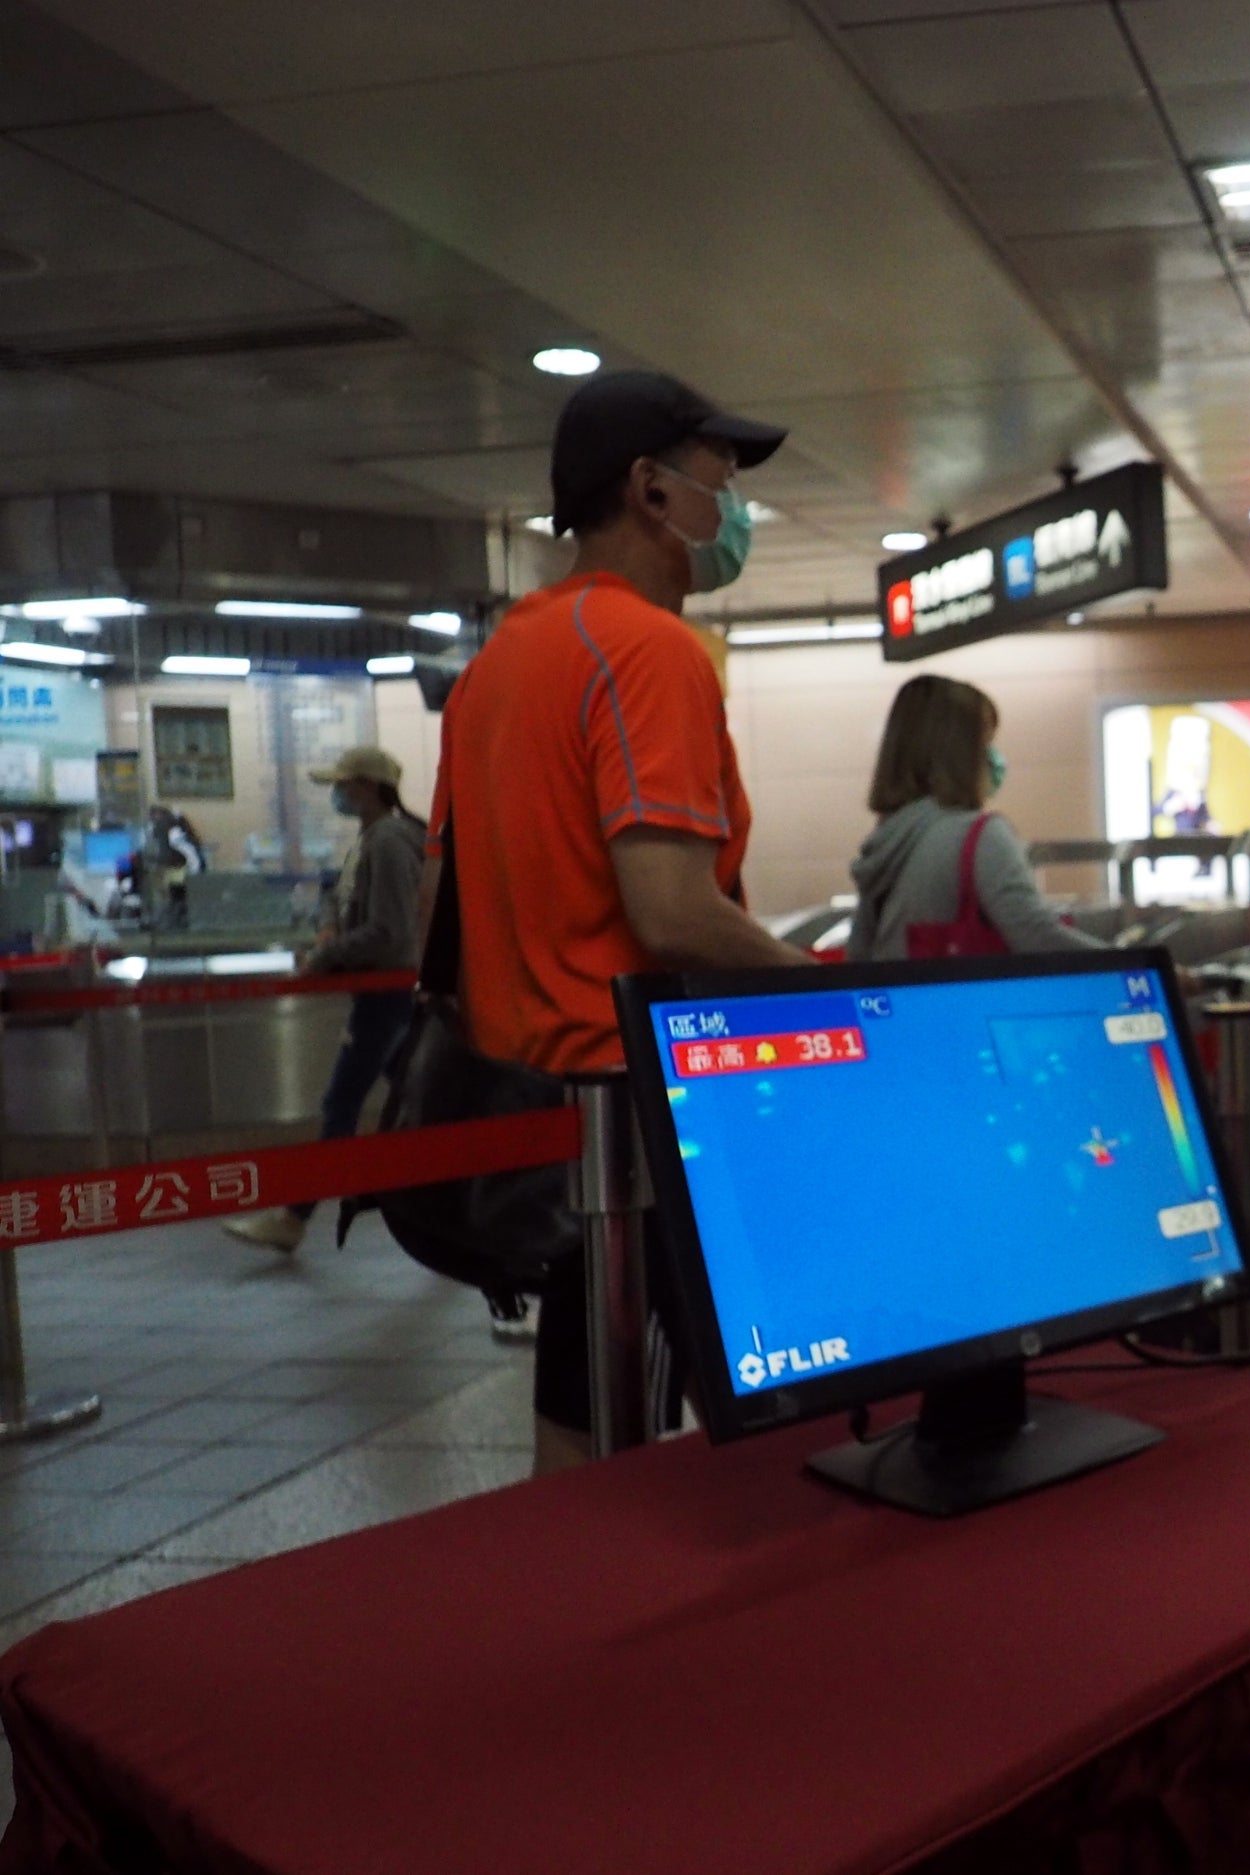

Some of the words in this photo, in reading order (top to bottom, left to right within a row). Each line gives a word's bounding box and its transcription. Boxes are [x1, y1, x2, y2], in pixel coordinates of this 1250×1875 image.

[1127, 976, 1150, 997] M
[687, 1044, 745, 1071] 最高
[796, 1031, 862, 1061] 38.1
[0, 1160, 259, 1238] 捷運公司
[766, 1336, 851, 1378] FLIR
